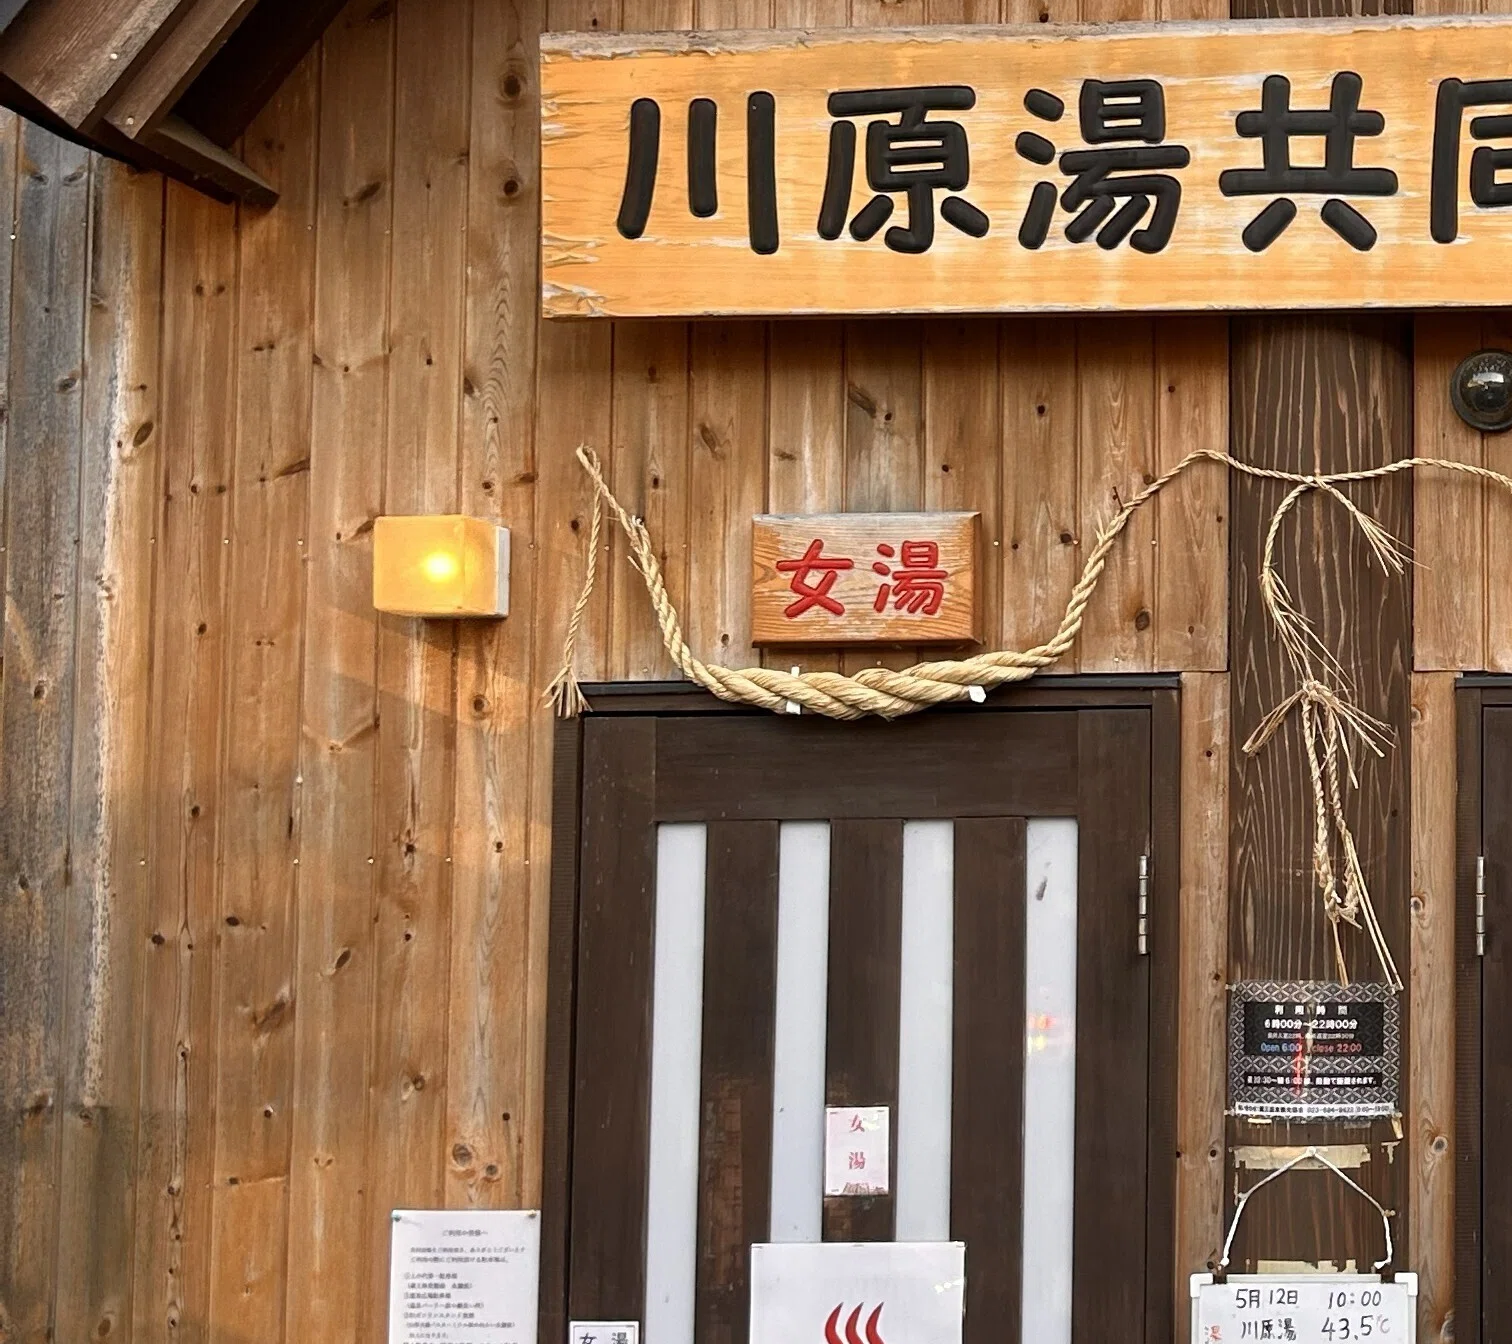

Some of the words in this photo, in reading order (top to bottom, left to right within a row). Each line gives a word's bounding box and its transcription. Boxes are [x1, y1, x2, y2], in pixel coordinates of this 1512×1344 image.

[774, 538, 947, 622] 女湯
[1328, 1290, 1382, 1309] 10:00
[1240, 1318, 1297, 1342] 川原湯
